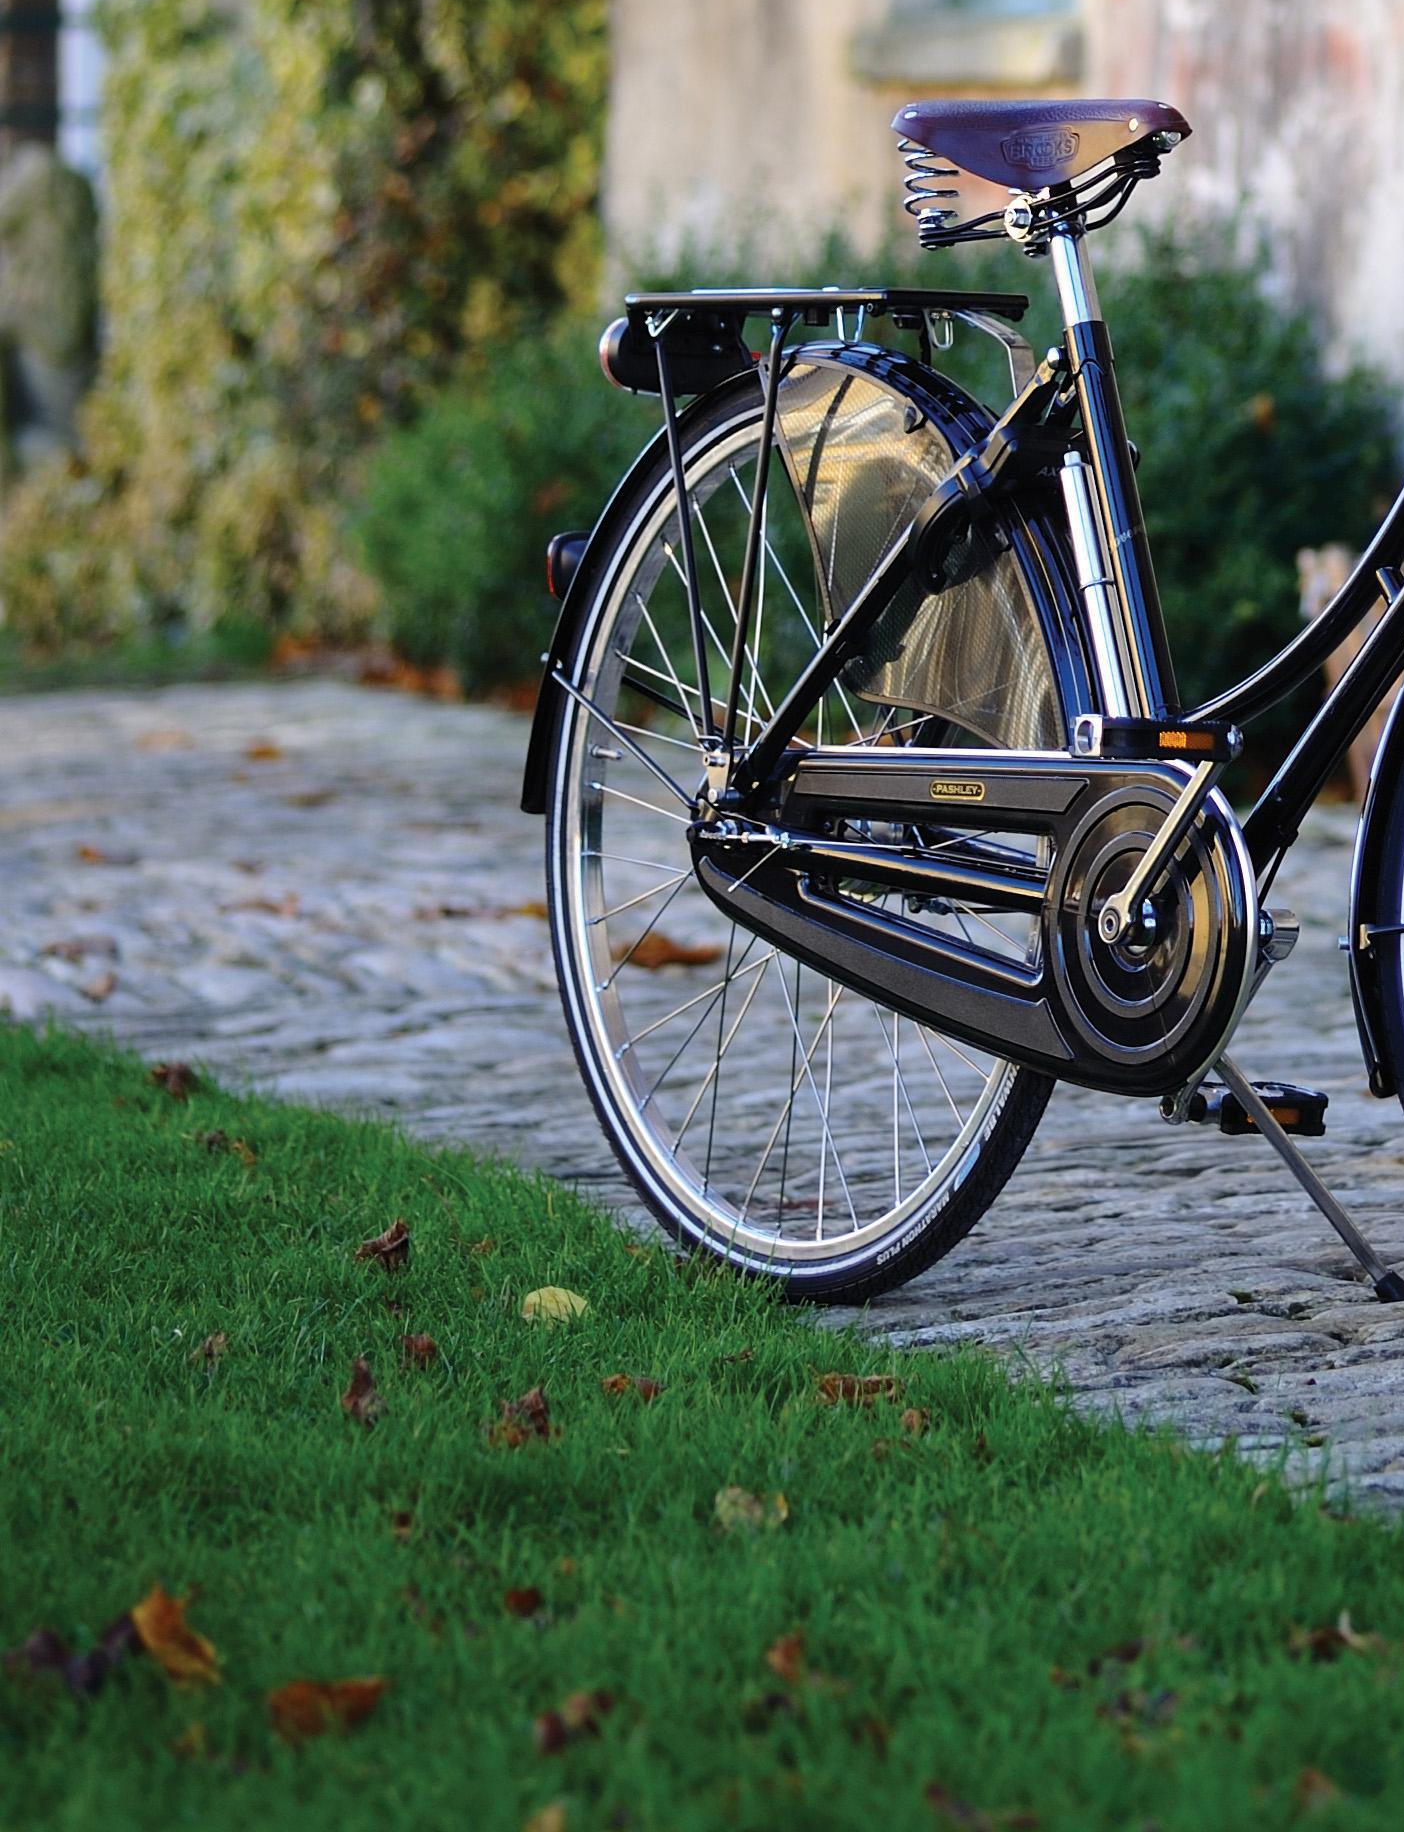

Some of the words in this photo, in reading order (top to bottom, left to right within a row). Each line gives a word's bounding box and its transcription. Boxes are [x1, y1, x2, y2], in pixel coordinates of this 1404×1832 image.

[1011, 138, 1072, 158] BROOKS
[936, 784, 978, 795] PASHLEY
[902, 1190, 950, 1248] MARATHON
[876, 1243, 901, 1266] PLUS
